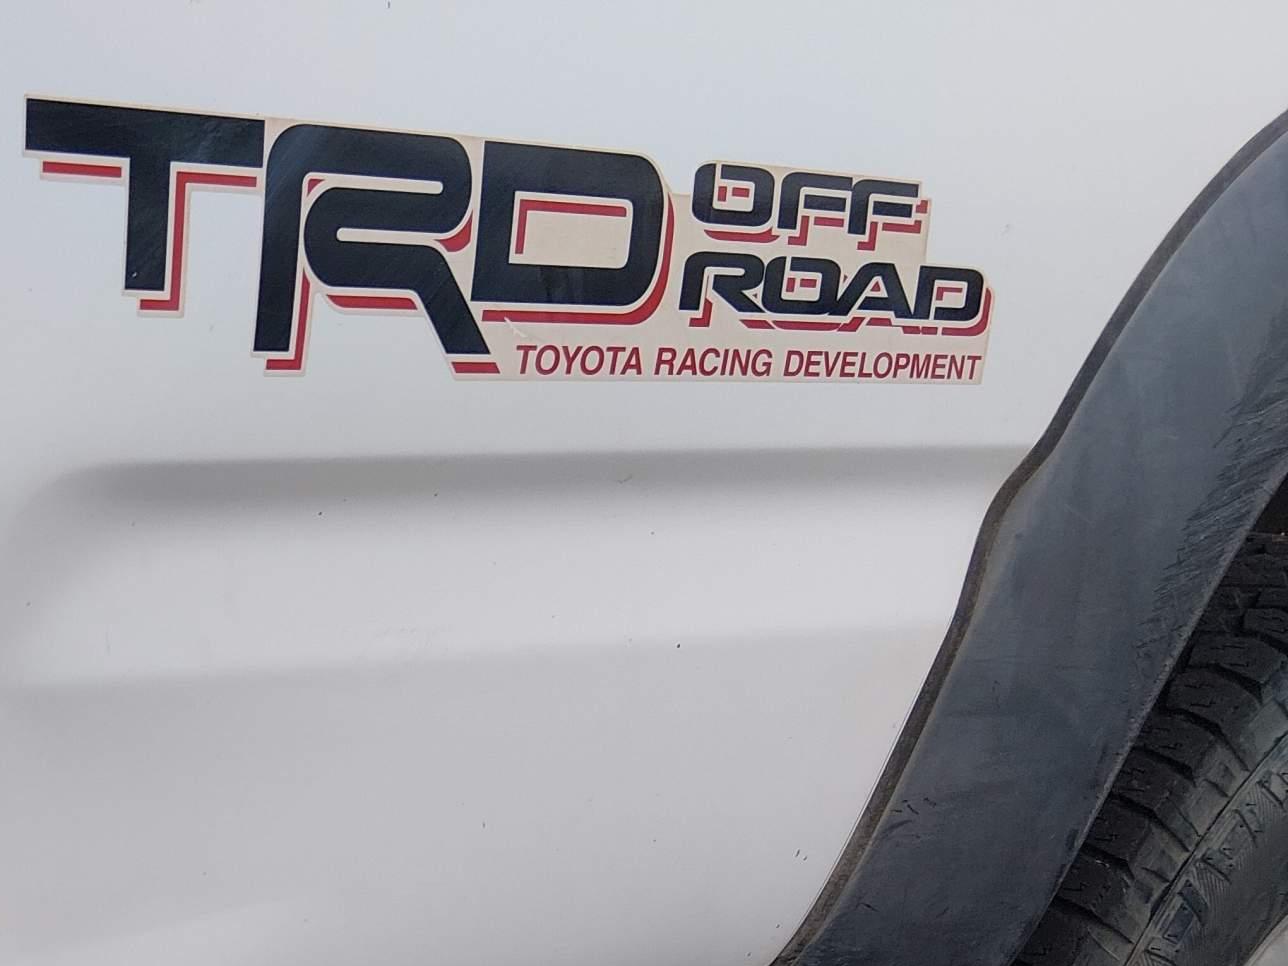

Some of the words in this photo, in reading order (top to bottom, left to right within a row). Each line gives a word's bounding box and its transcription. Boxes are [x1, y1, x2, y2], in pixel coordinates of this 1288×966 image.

[25, 97, 674, 374] TRD
[691, 162, 930, 250] OFF
[678, 250, 993, 335] ROAD
[515, 344, 642, 376] TOYOTA
[653, 347, 772, 377] RACING
[782, 350, 982, 380] DEVELOPMENT
